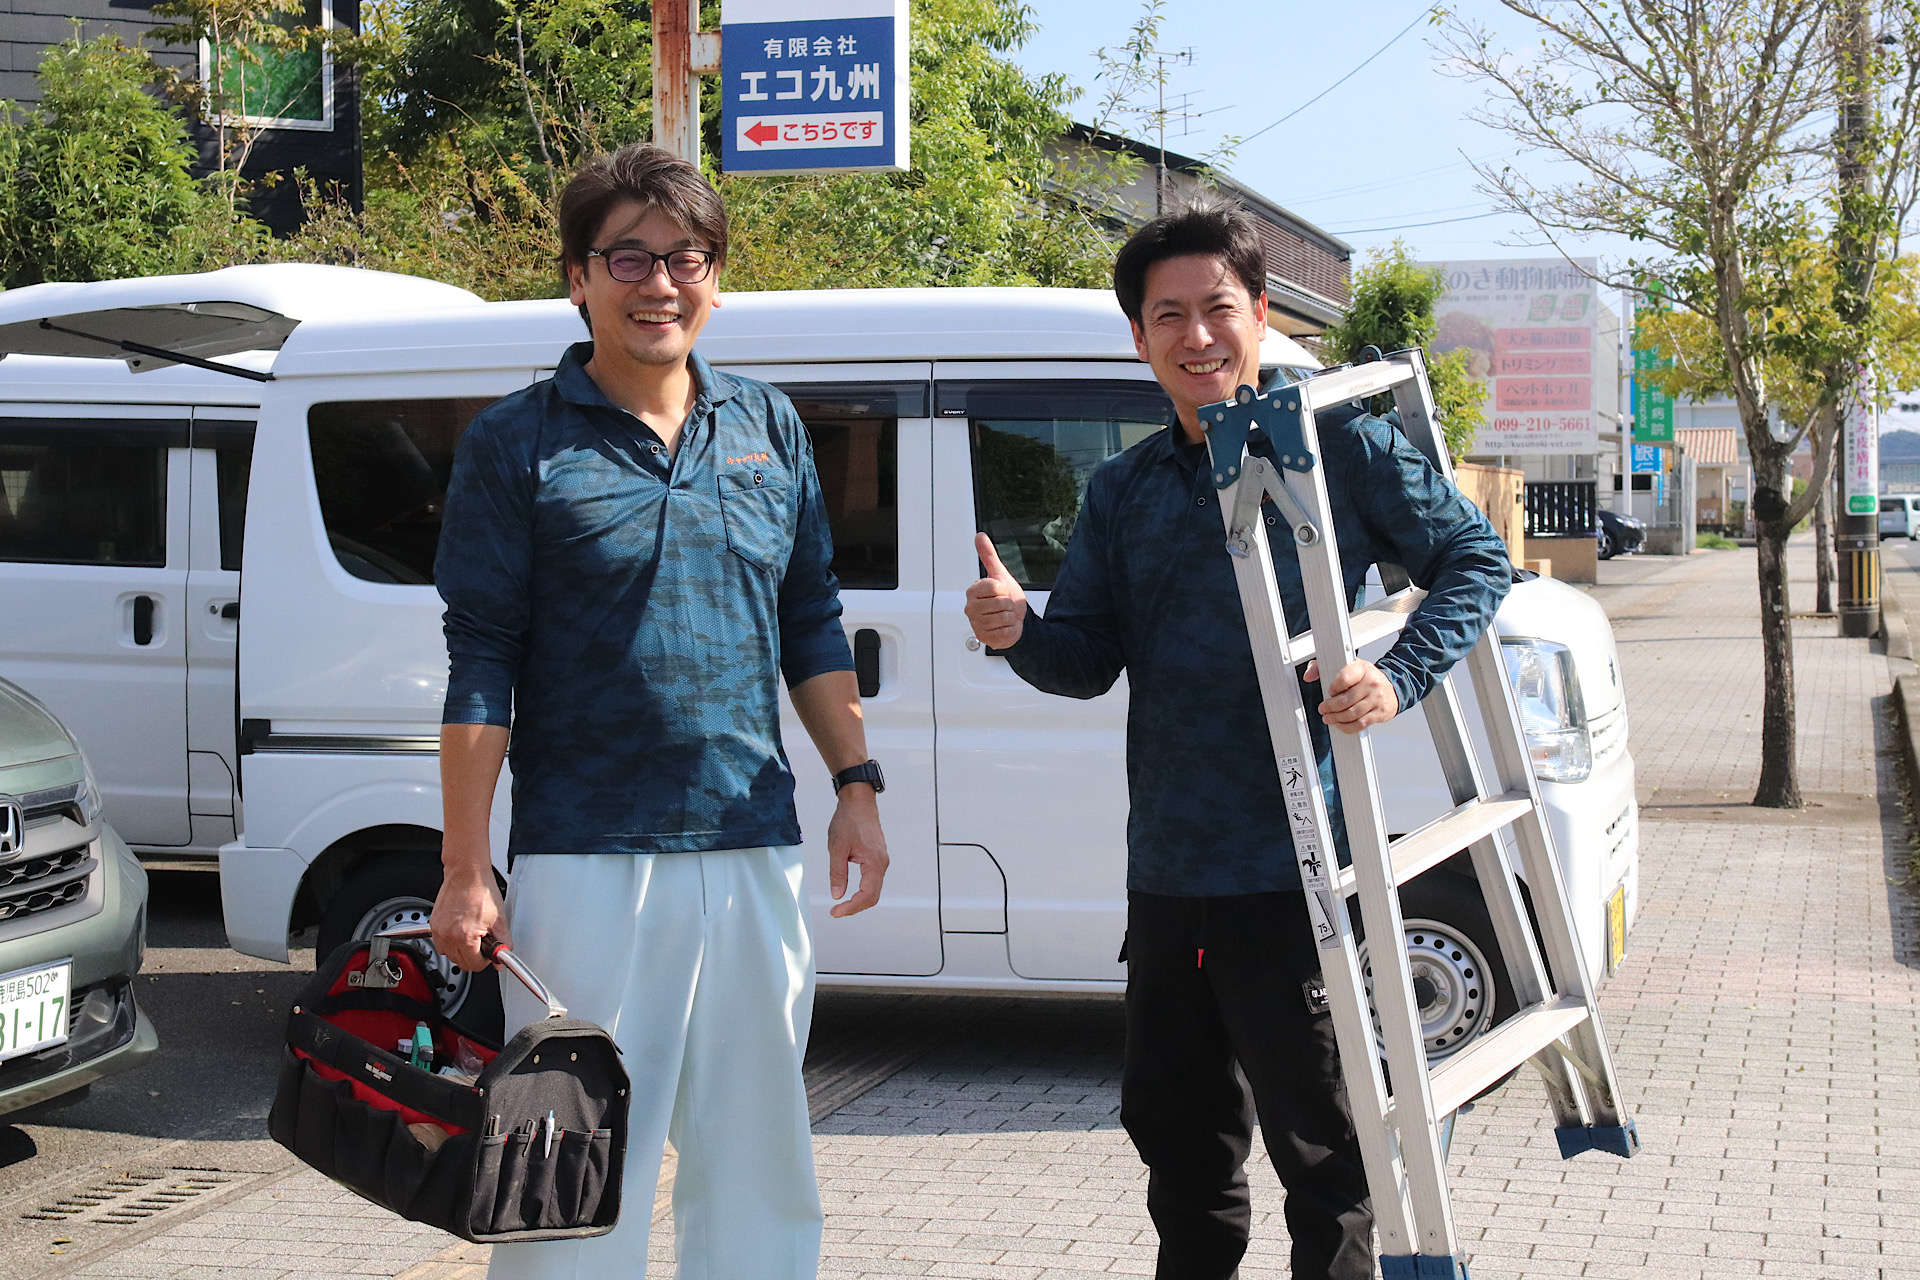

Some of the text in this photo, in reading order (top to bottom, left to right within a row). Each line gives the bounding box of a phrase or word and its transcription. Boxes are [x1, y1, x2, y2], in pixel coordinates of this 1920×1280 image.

[763, 34, 858, 59] 有限会社
[739, 62, 880, 102] エコ九州
[783, 120, 877, 142] こちらです
[1446, 266, 1593, 290] のき動物病院
[1494, 417, 1591, 431] 099-210-5661
[1485, 440, 1583, 449] http://kusunoki-vet.com
